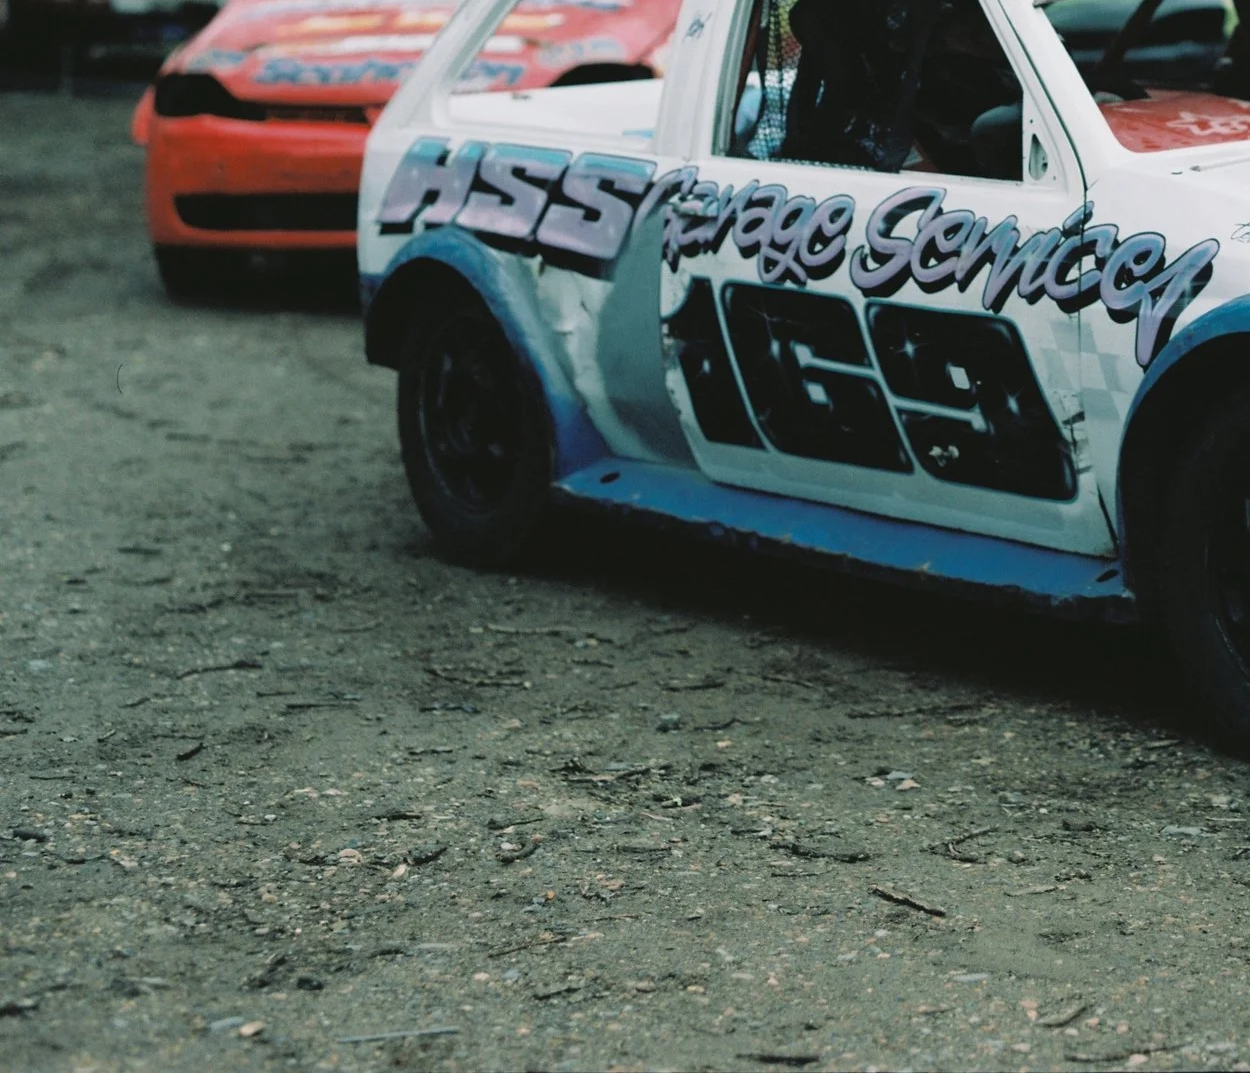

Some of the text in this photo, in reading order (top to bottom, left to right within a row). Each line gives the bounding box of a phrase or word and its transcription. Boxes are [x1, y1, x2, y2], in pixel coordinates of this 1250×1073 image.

[376, 136, 659, 272] HSS
[632, 165, 855, 287] Garage
[662, 275, 1078, 502] 169
